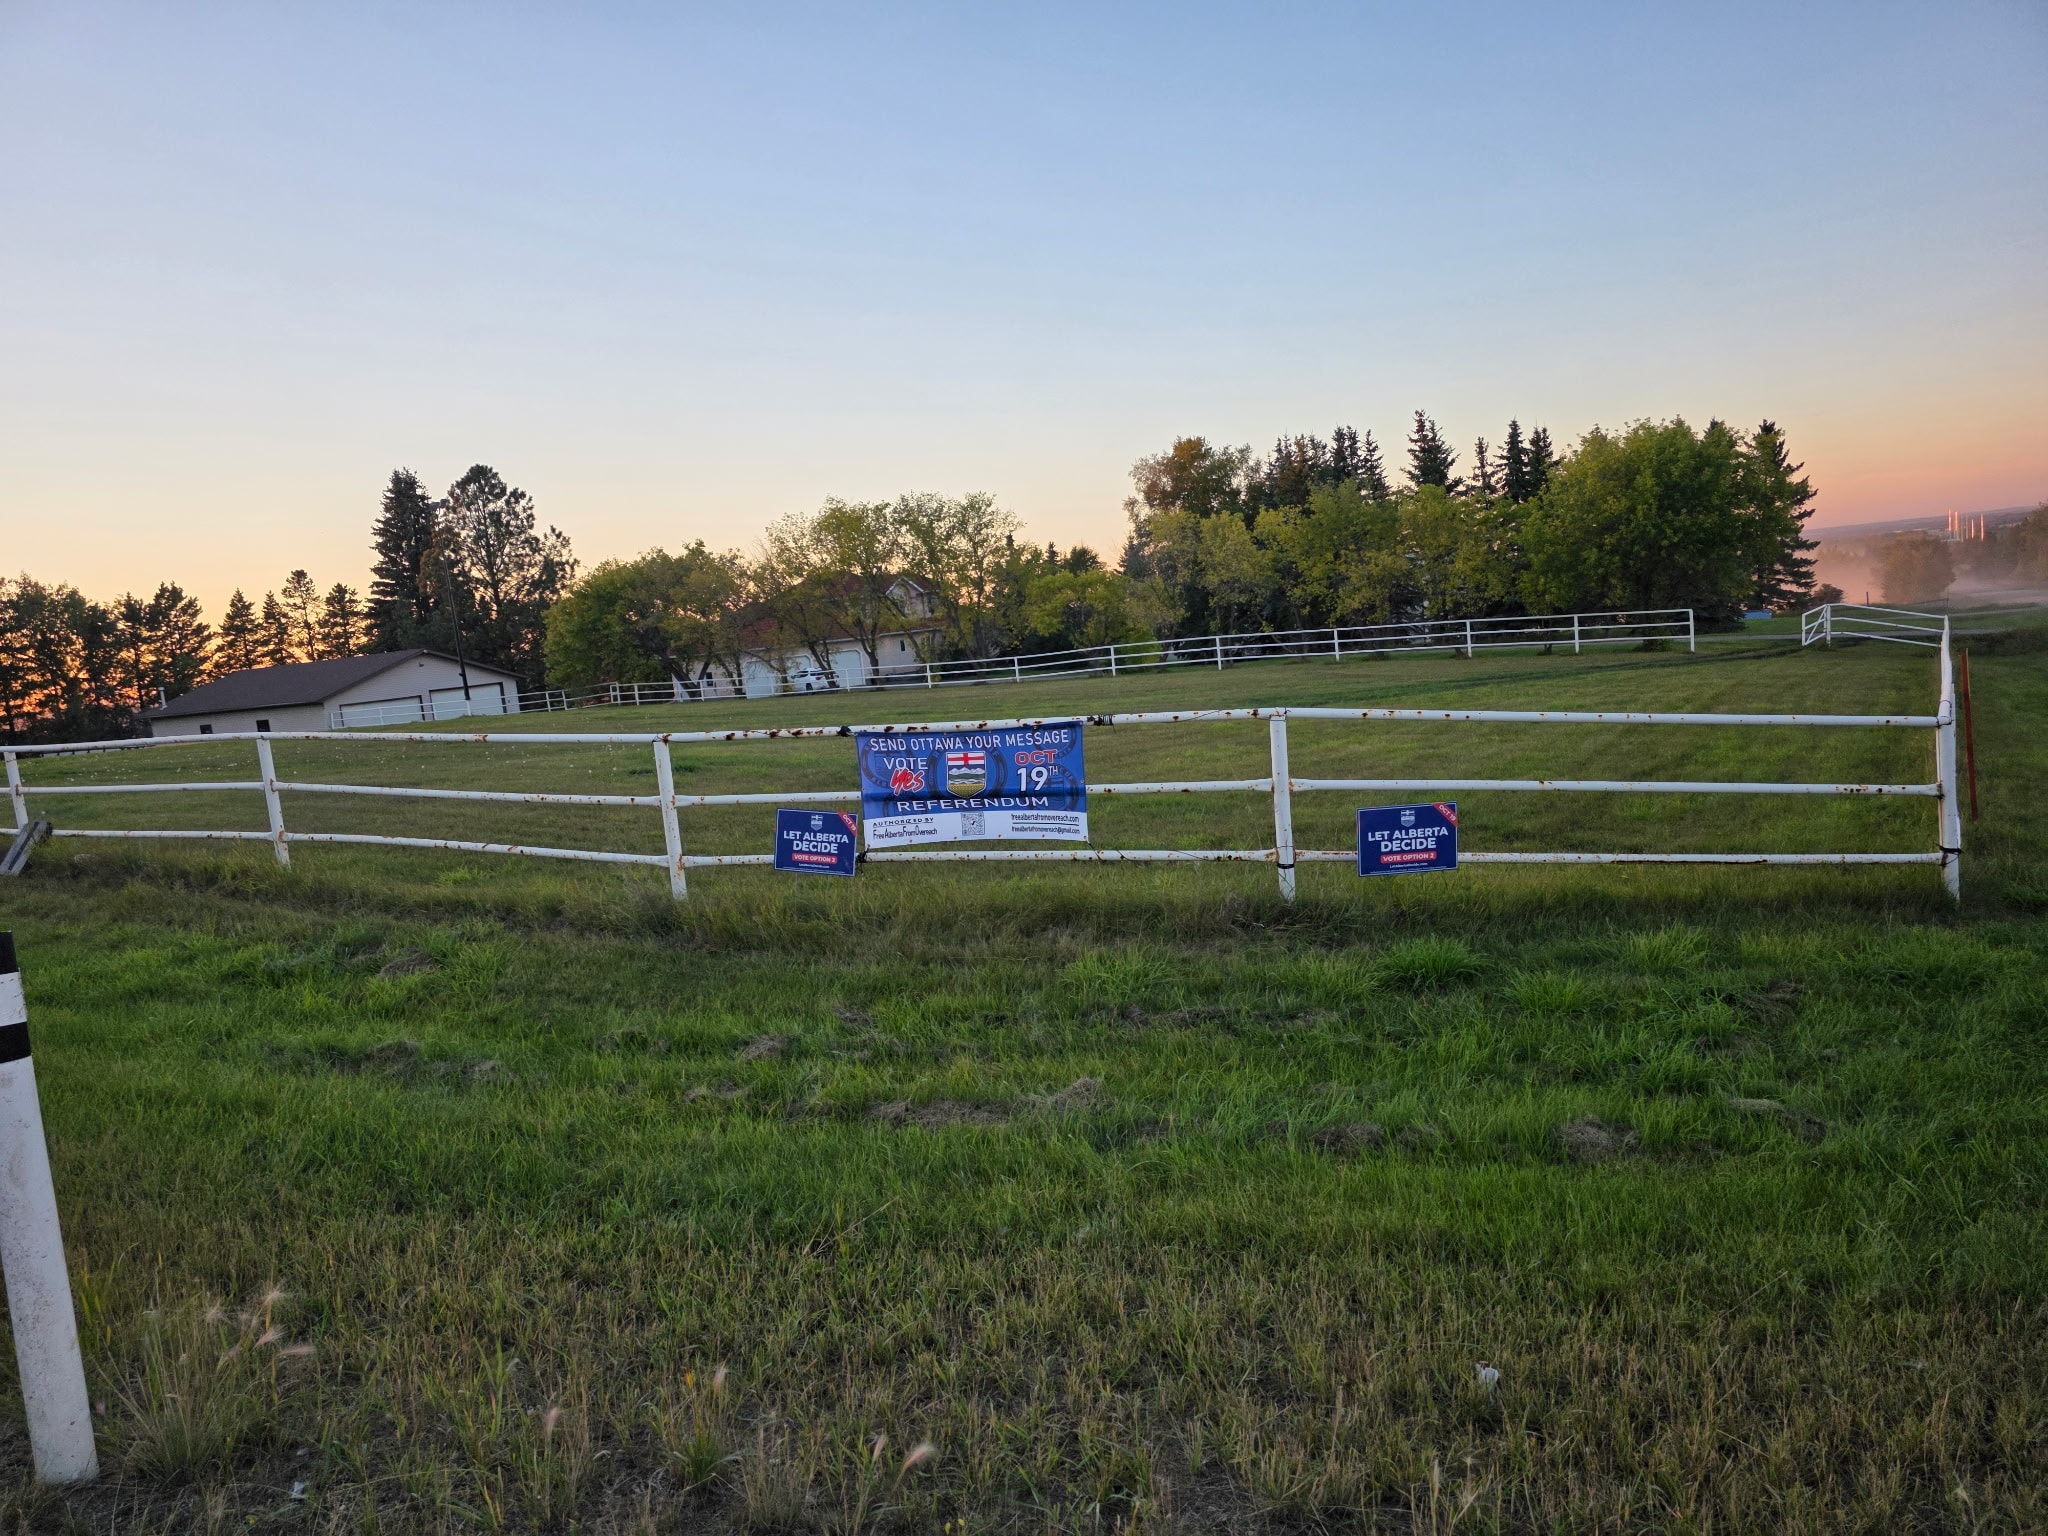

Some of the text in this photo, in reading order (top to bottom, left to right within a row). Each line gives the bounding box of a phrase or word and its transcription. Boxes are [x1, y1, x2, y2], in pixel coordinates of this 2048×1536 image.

[870, 729, 1069, 752] SEND OTTAWA YOUR MESSAGE
[883, 757, 929, 770] VOTE
[1014, 749, 1058, 766] OCT
[897, 796, 1049, 812] REFERENDUM
[1439, 805, 1451, 815] OCT
[843, 814, 853, 825] OCT
[873, 818, 923, 828] AUTHORIZED
[784, 831, 849, 843] LET ALBERTA
[1368, 827, 1448, 841] LET ALBERTA
[793, 840, 838, 853] DECIDE
[1381, 838, 1437, 852] DECIDE
[1403, 853, 1429, 861] OPTION
